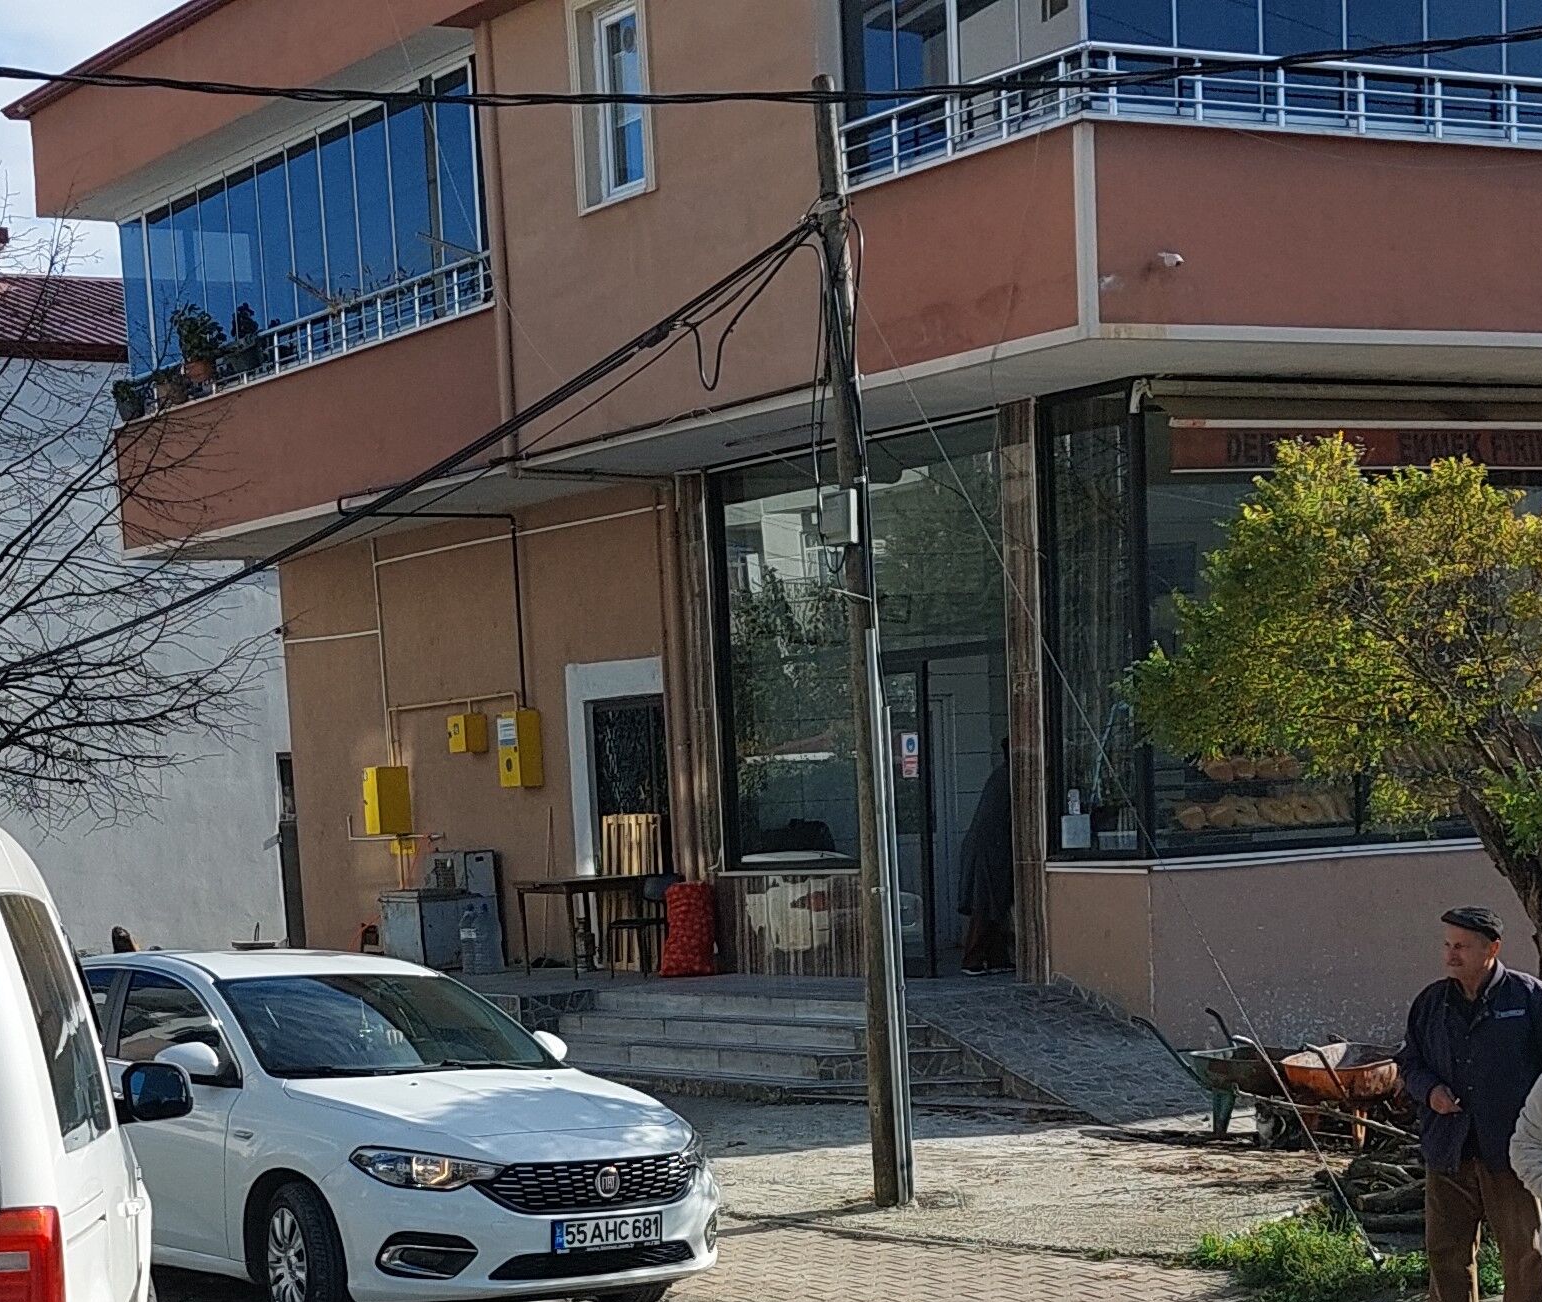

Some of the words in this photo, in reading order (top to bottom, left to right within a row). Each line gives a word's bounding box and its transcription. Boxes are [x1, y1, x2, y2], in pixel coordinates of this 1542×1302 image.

[1399, 431, 1482, 462] EKMEK
[565, 1222, 588, 1245] 55
[590, 1219, 630, 1243] AHC
[632, 1216, 659, 1239] 681
